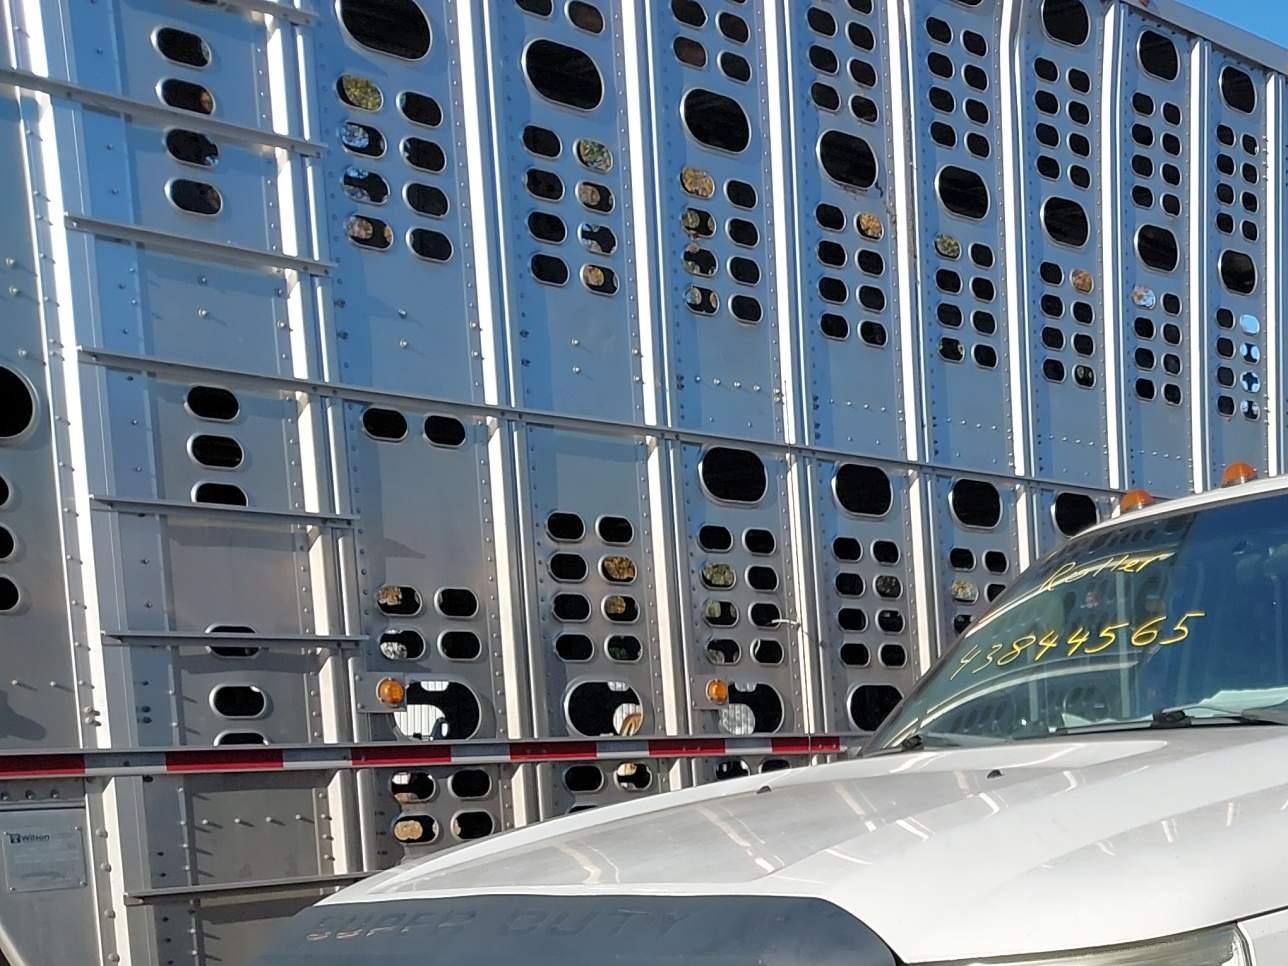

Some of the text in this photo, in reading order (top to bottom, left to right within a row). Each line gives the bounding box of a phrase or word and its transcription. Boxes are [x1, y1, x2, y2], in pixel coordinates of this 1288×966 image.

[949, 612, 1206, 681] 43844565
[305, 906, 691, 942] SUPER DUTY
